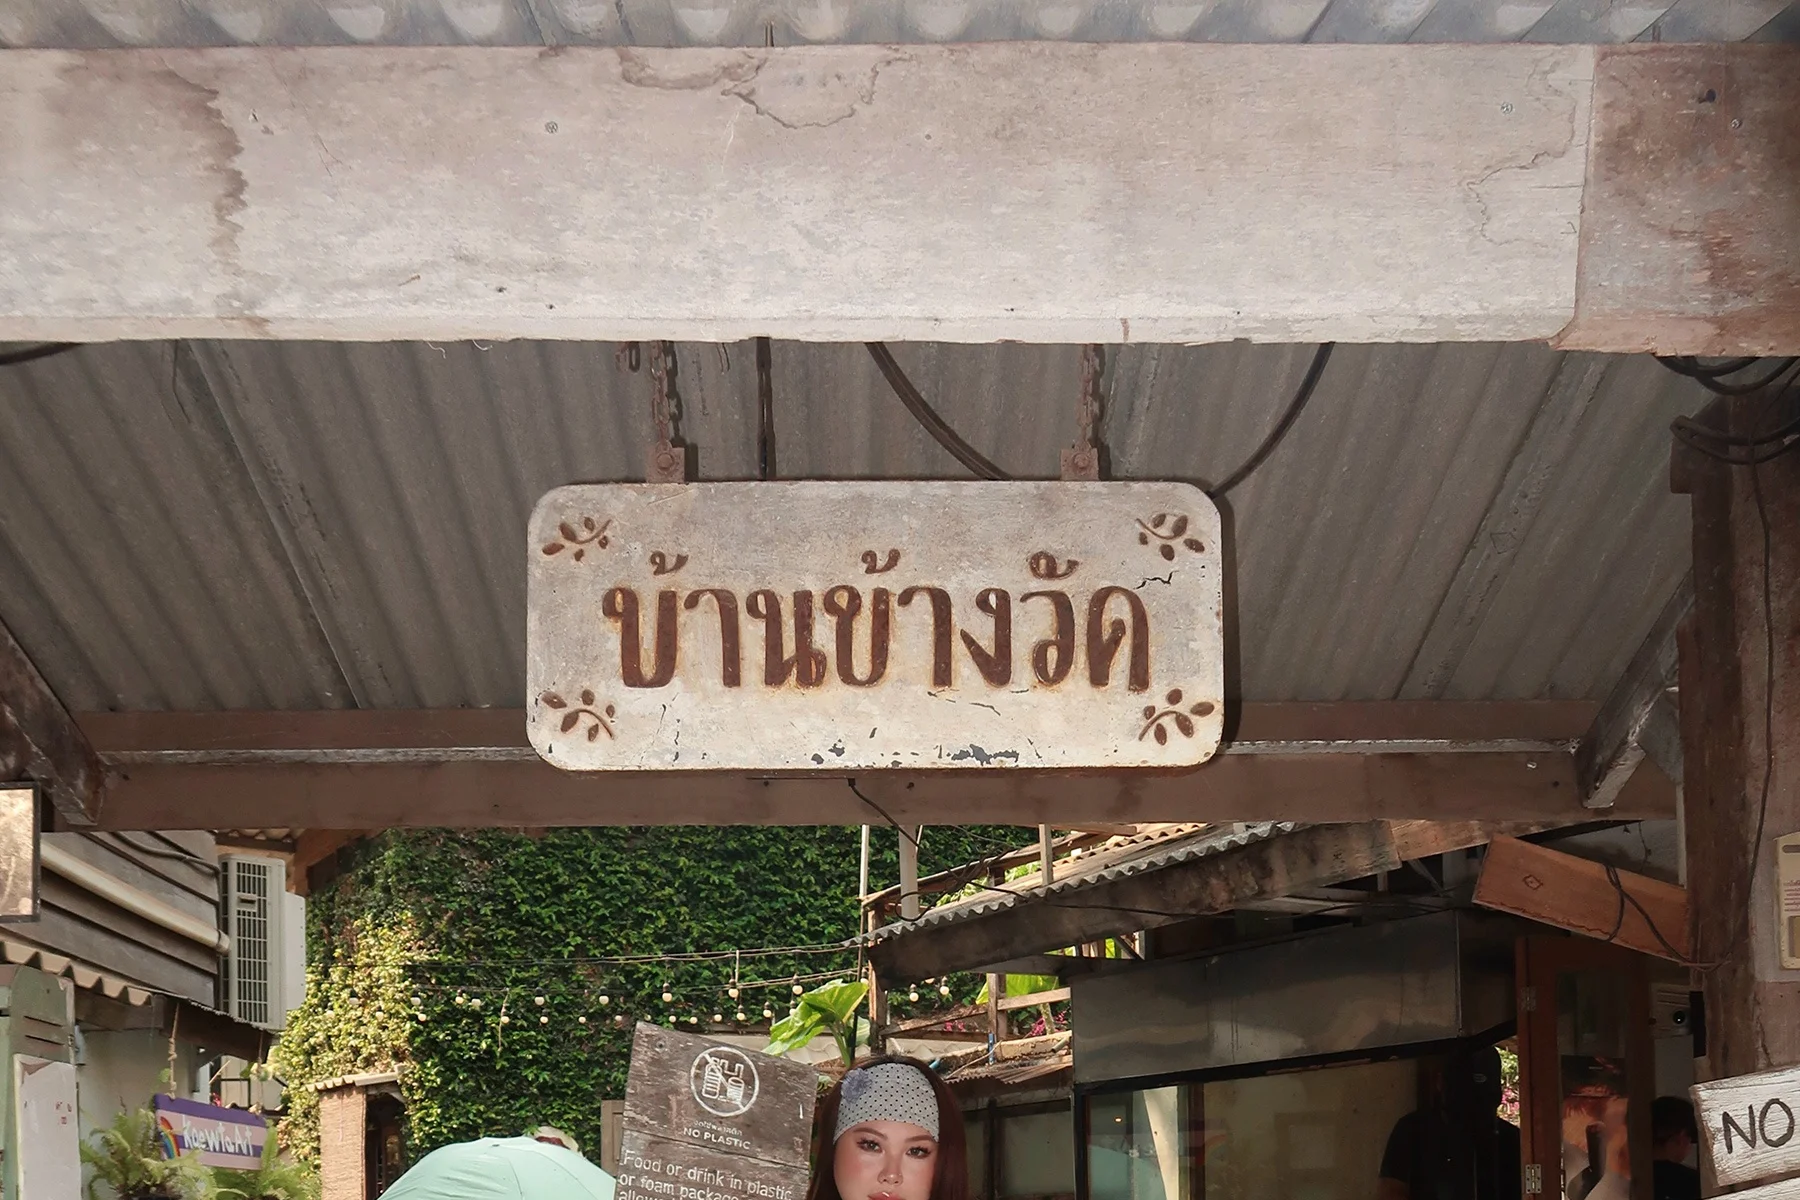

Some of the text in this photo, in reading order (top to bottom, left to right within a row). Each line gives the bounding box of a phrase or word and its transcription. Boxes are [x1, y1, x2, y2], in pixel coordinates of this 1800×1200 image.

[602, 549, 1150, 692] บ้านข้างวัด
[683, 1127, 751, 1150] NO PLASTIC
[1722, 1097, 1796, 1154] NO
[619, 1173, 636, 1186] or
[640, 1175, 675, 1195] foam
[622, 1150, 662, 1172] Food
[666, 1163, 683, 1176] or
[687, 1167, 725, 1186] drink
[730, 1174, 743, 1190] in
